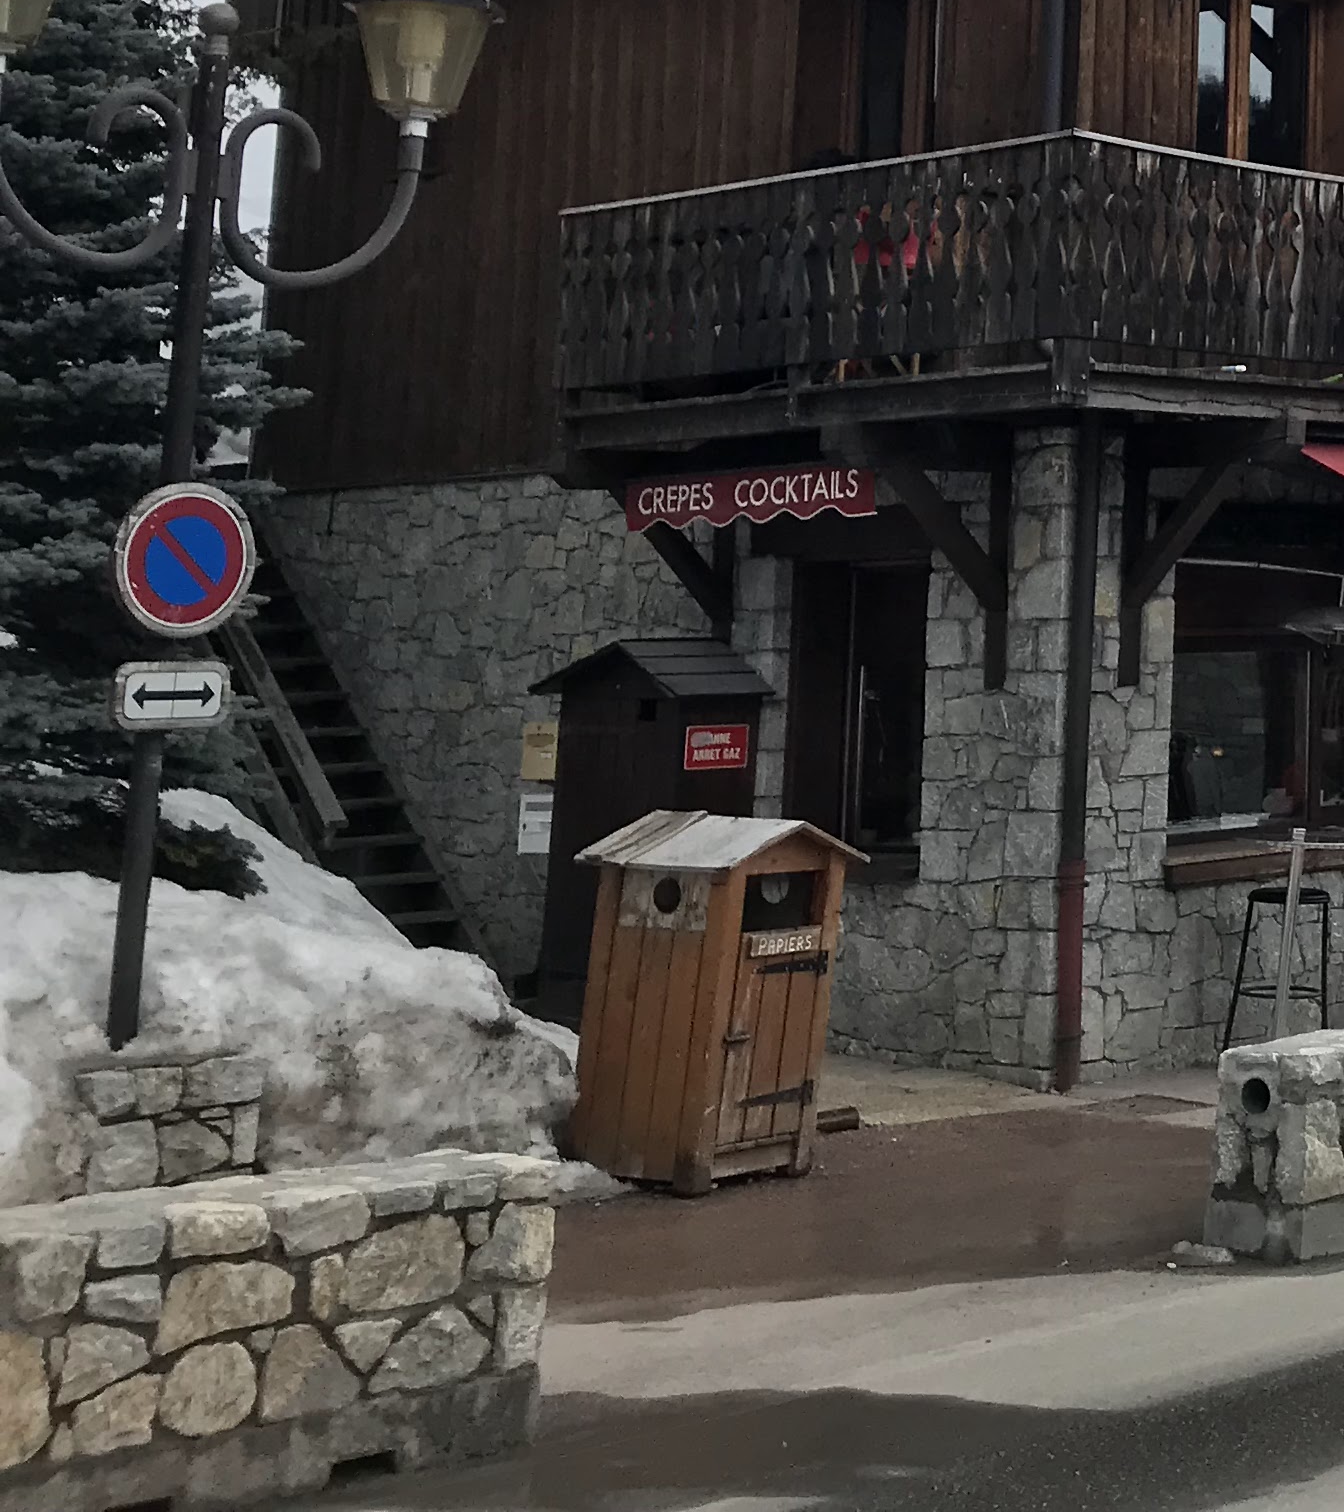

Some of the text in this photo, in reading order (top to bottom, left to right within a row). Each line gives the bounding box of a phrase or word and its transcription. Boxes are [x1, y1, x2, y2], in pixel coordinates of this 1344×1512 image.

[637, 469, 859, 515] CREPES COCKTAILS
[723, 747, 741, 759] GAZ
[758, 934, 812, 956] PAPIERS
